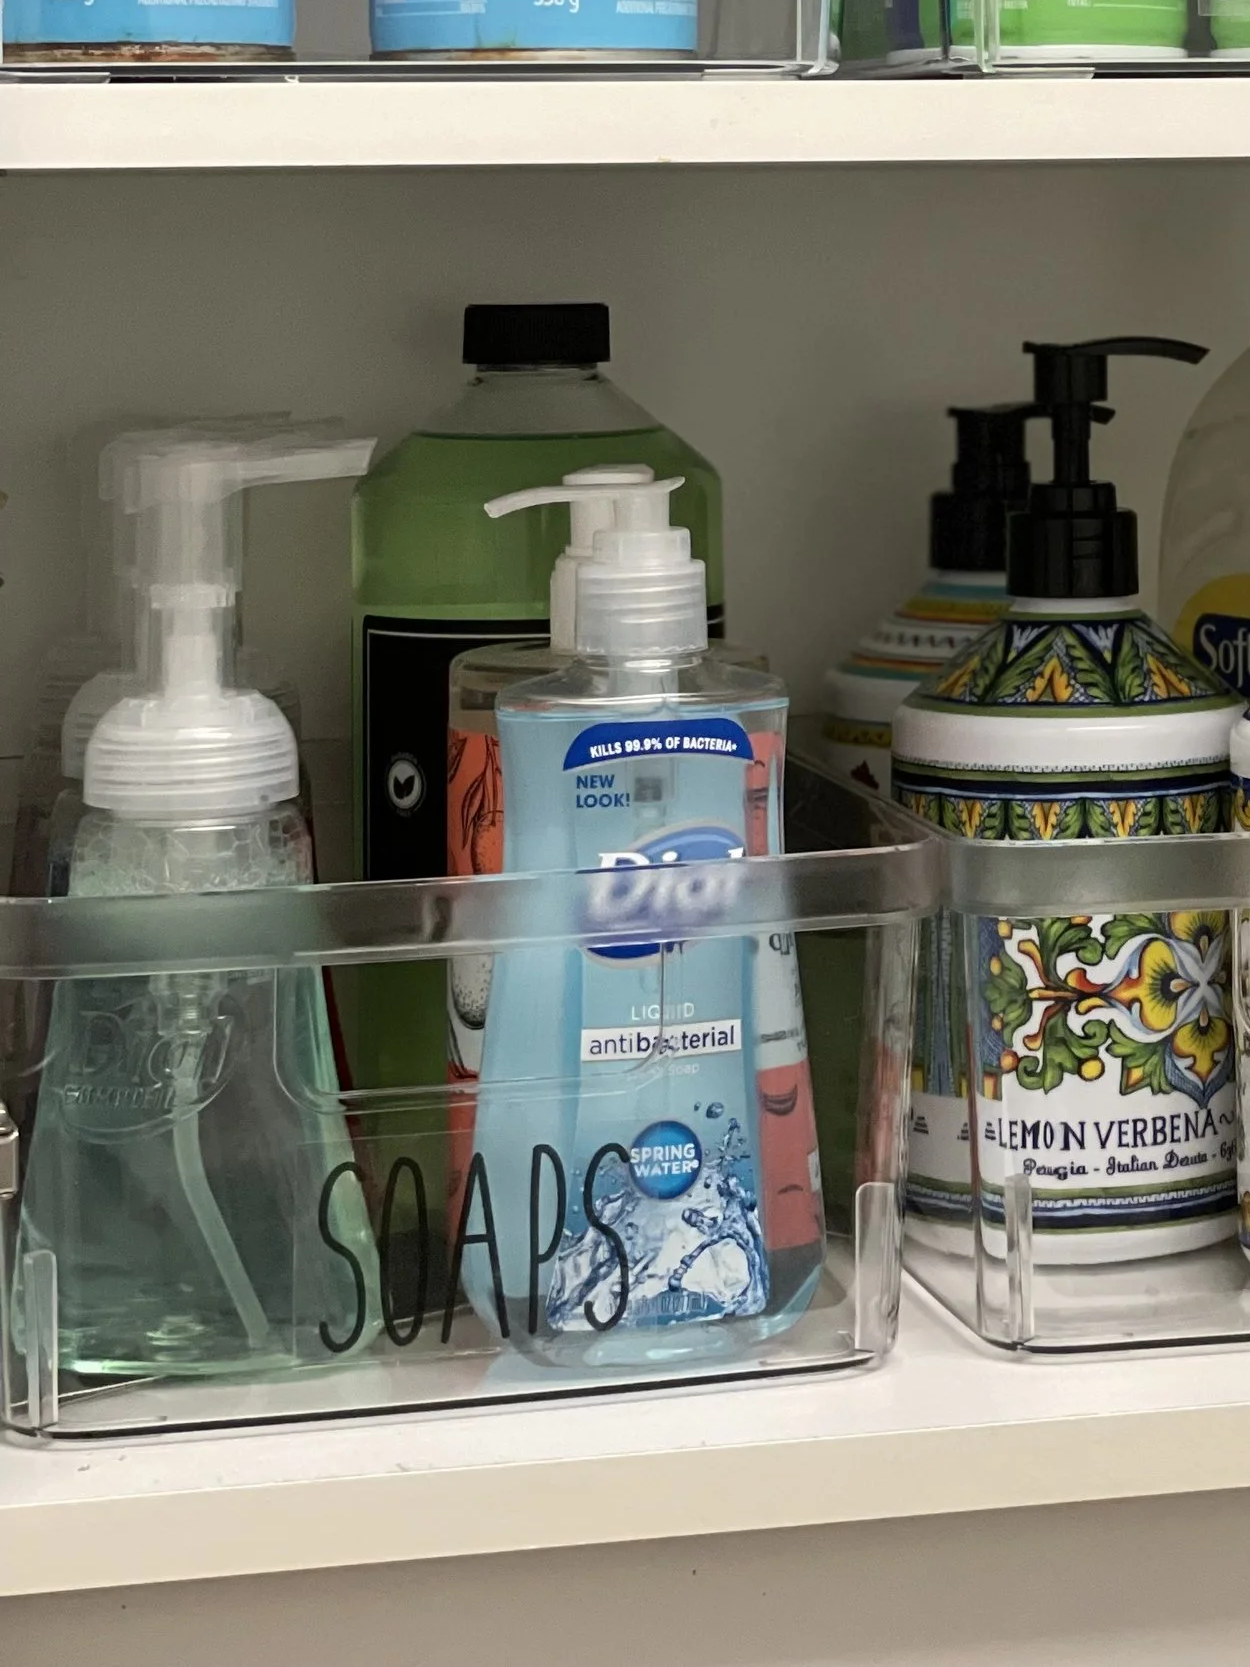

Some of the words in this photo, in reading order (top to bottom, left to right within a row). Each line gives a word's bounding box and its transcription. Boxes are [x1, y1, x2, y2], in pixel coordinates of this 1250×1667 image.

[590, 741, 622, 758] KILLS
[625, 738, 662, 752] 99.9%
[665, 737, 680, 749] OF
[576, 774, 615, 789] NEW
[576, 793, 630, 808] LOOK!
[998, 1117, 1086, 1151] LEMON
[1093, 1108, 1219, 1150] VERBENA
[630, 1143, 695, 1163] SPRING
[1023, 1158, 1088, 1180] Perugia
[1106, 1155, 1157, 1176] Italian
[319, 1143, 633, 1352] SOAPS
